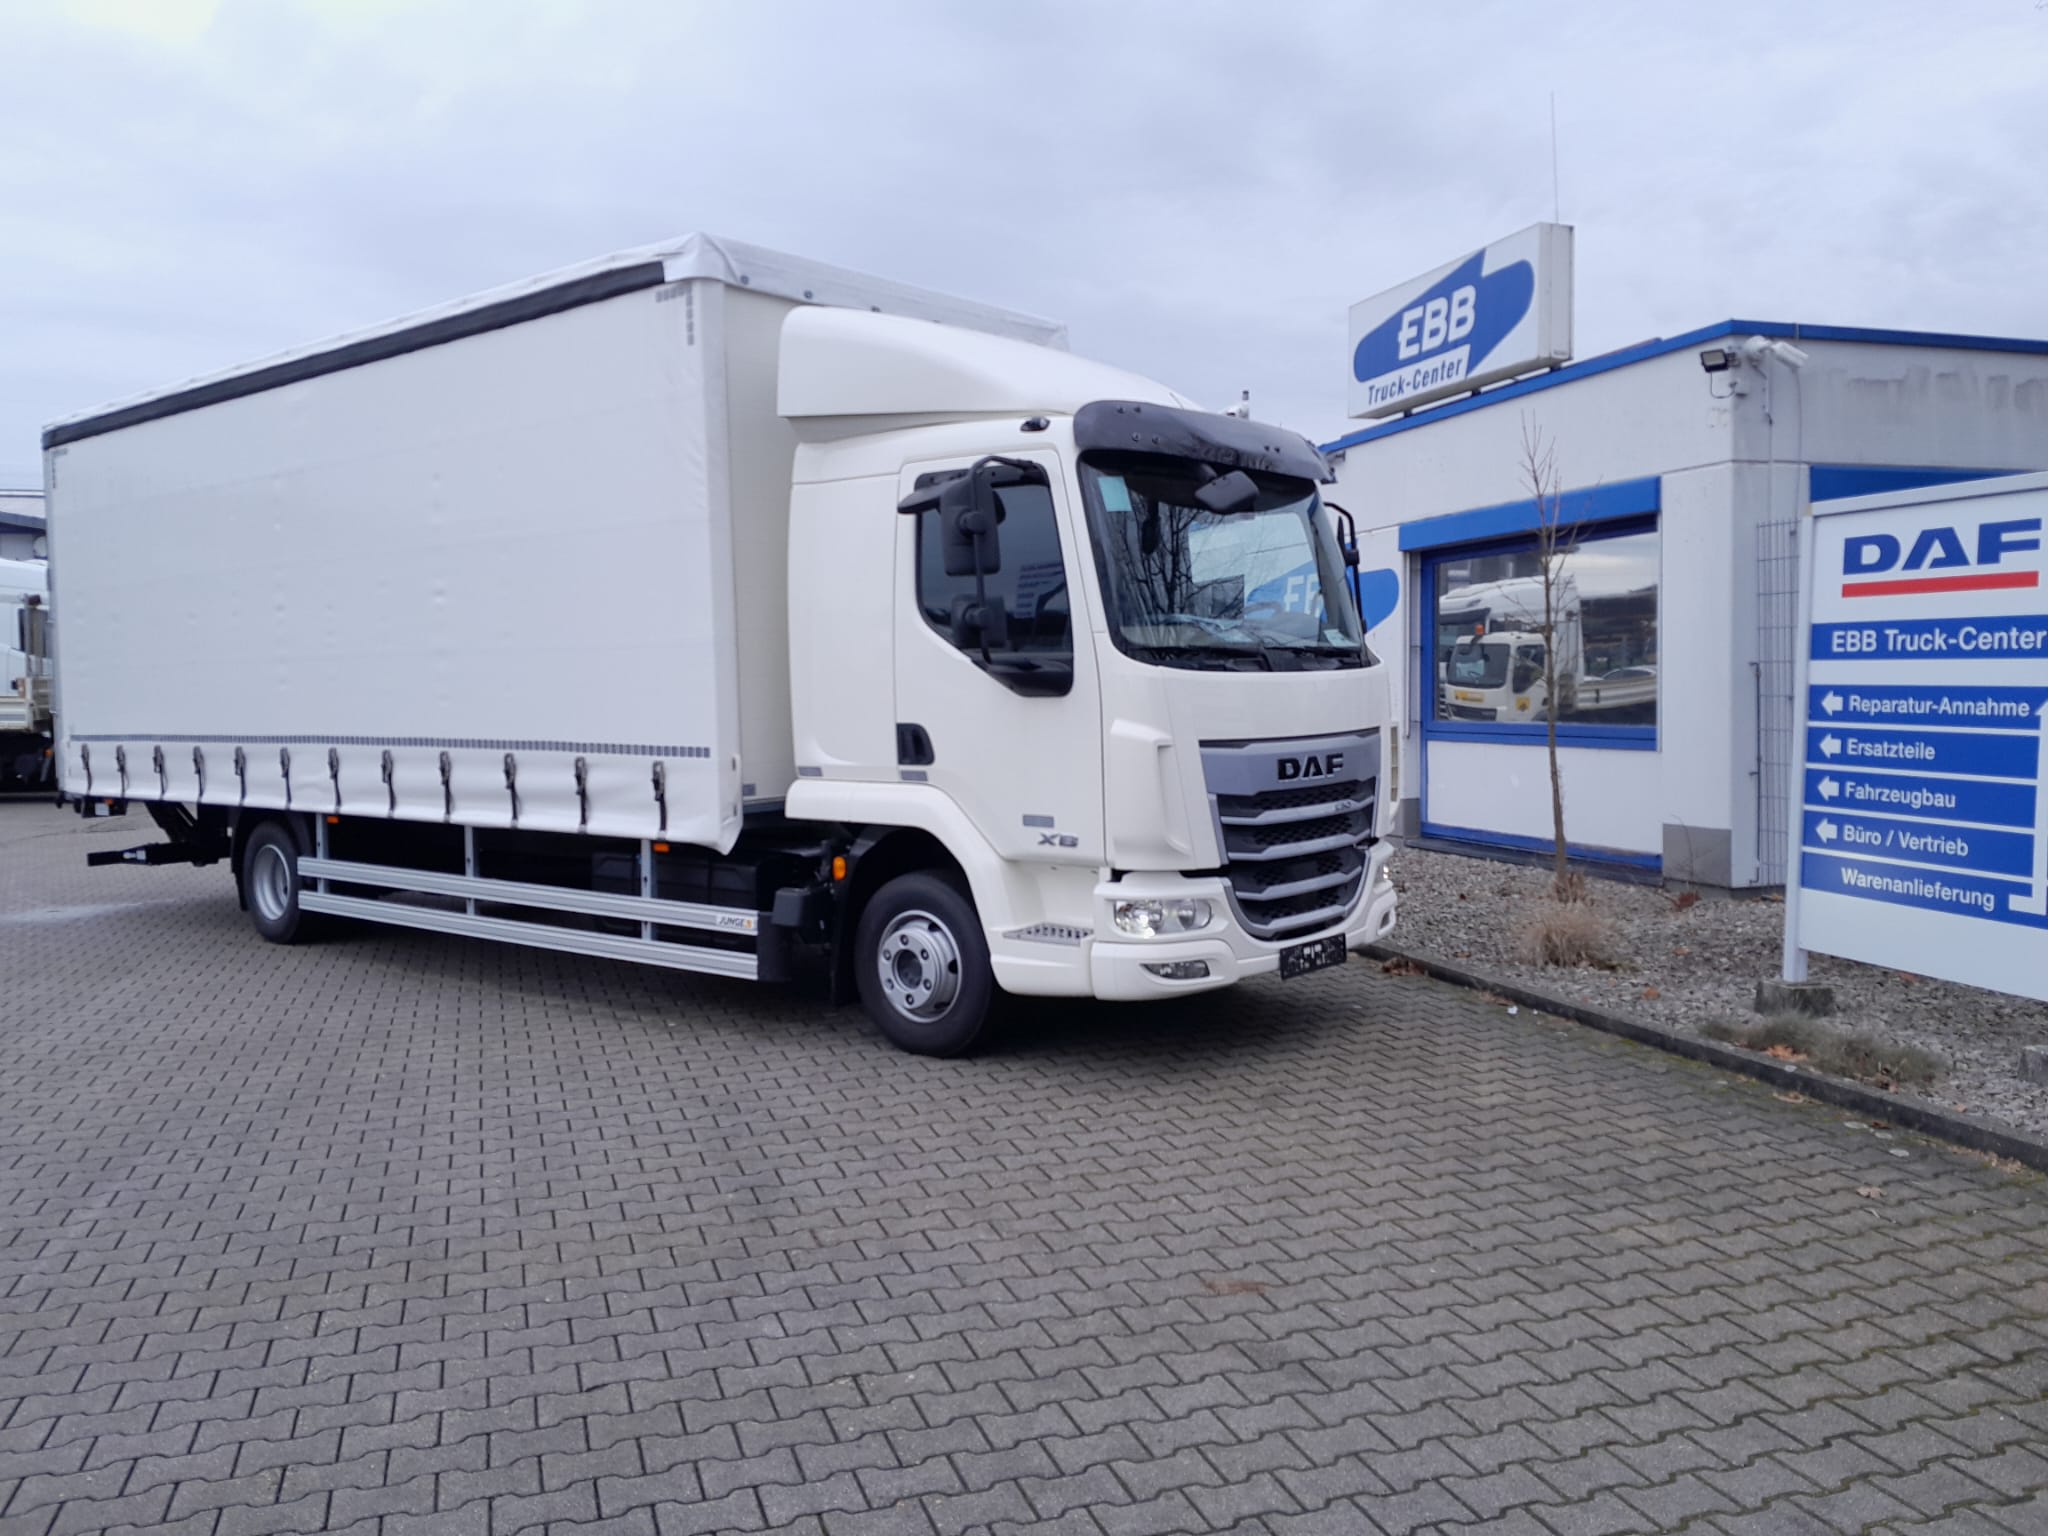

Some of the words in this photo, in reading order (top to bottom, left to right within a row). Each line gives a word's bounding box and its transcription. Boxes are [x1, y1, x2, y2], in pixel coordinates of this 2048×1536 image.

[1398, 285, 1477, 361] EBB
[1368, 356, 1464, 406] Truck-Center
[1843, 518, 2042, 576] DAF
[1831, 629, 1878, 654] EBB
[1884, 625, 2048, 652] Truck-Center
[1848, 694, 2031, 717] Reparatur-Annahme
[1846, 737, 1936, 761] Ersatzteile
[1277, 753, 1344, 781] DAF
[1844, 781, 1957, 809] Fahrzeugbau
[1843, 824, 1882, 846] Büro
[1897, 830, 1969, 857] Vertrieb
[1841, 866, 1996, 911] Warenanlieferung
